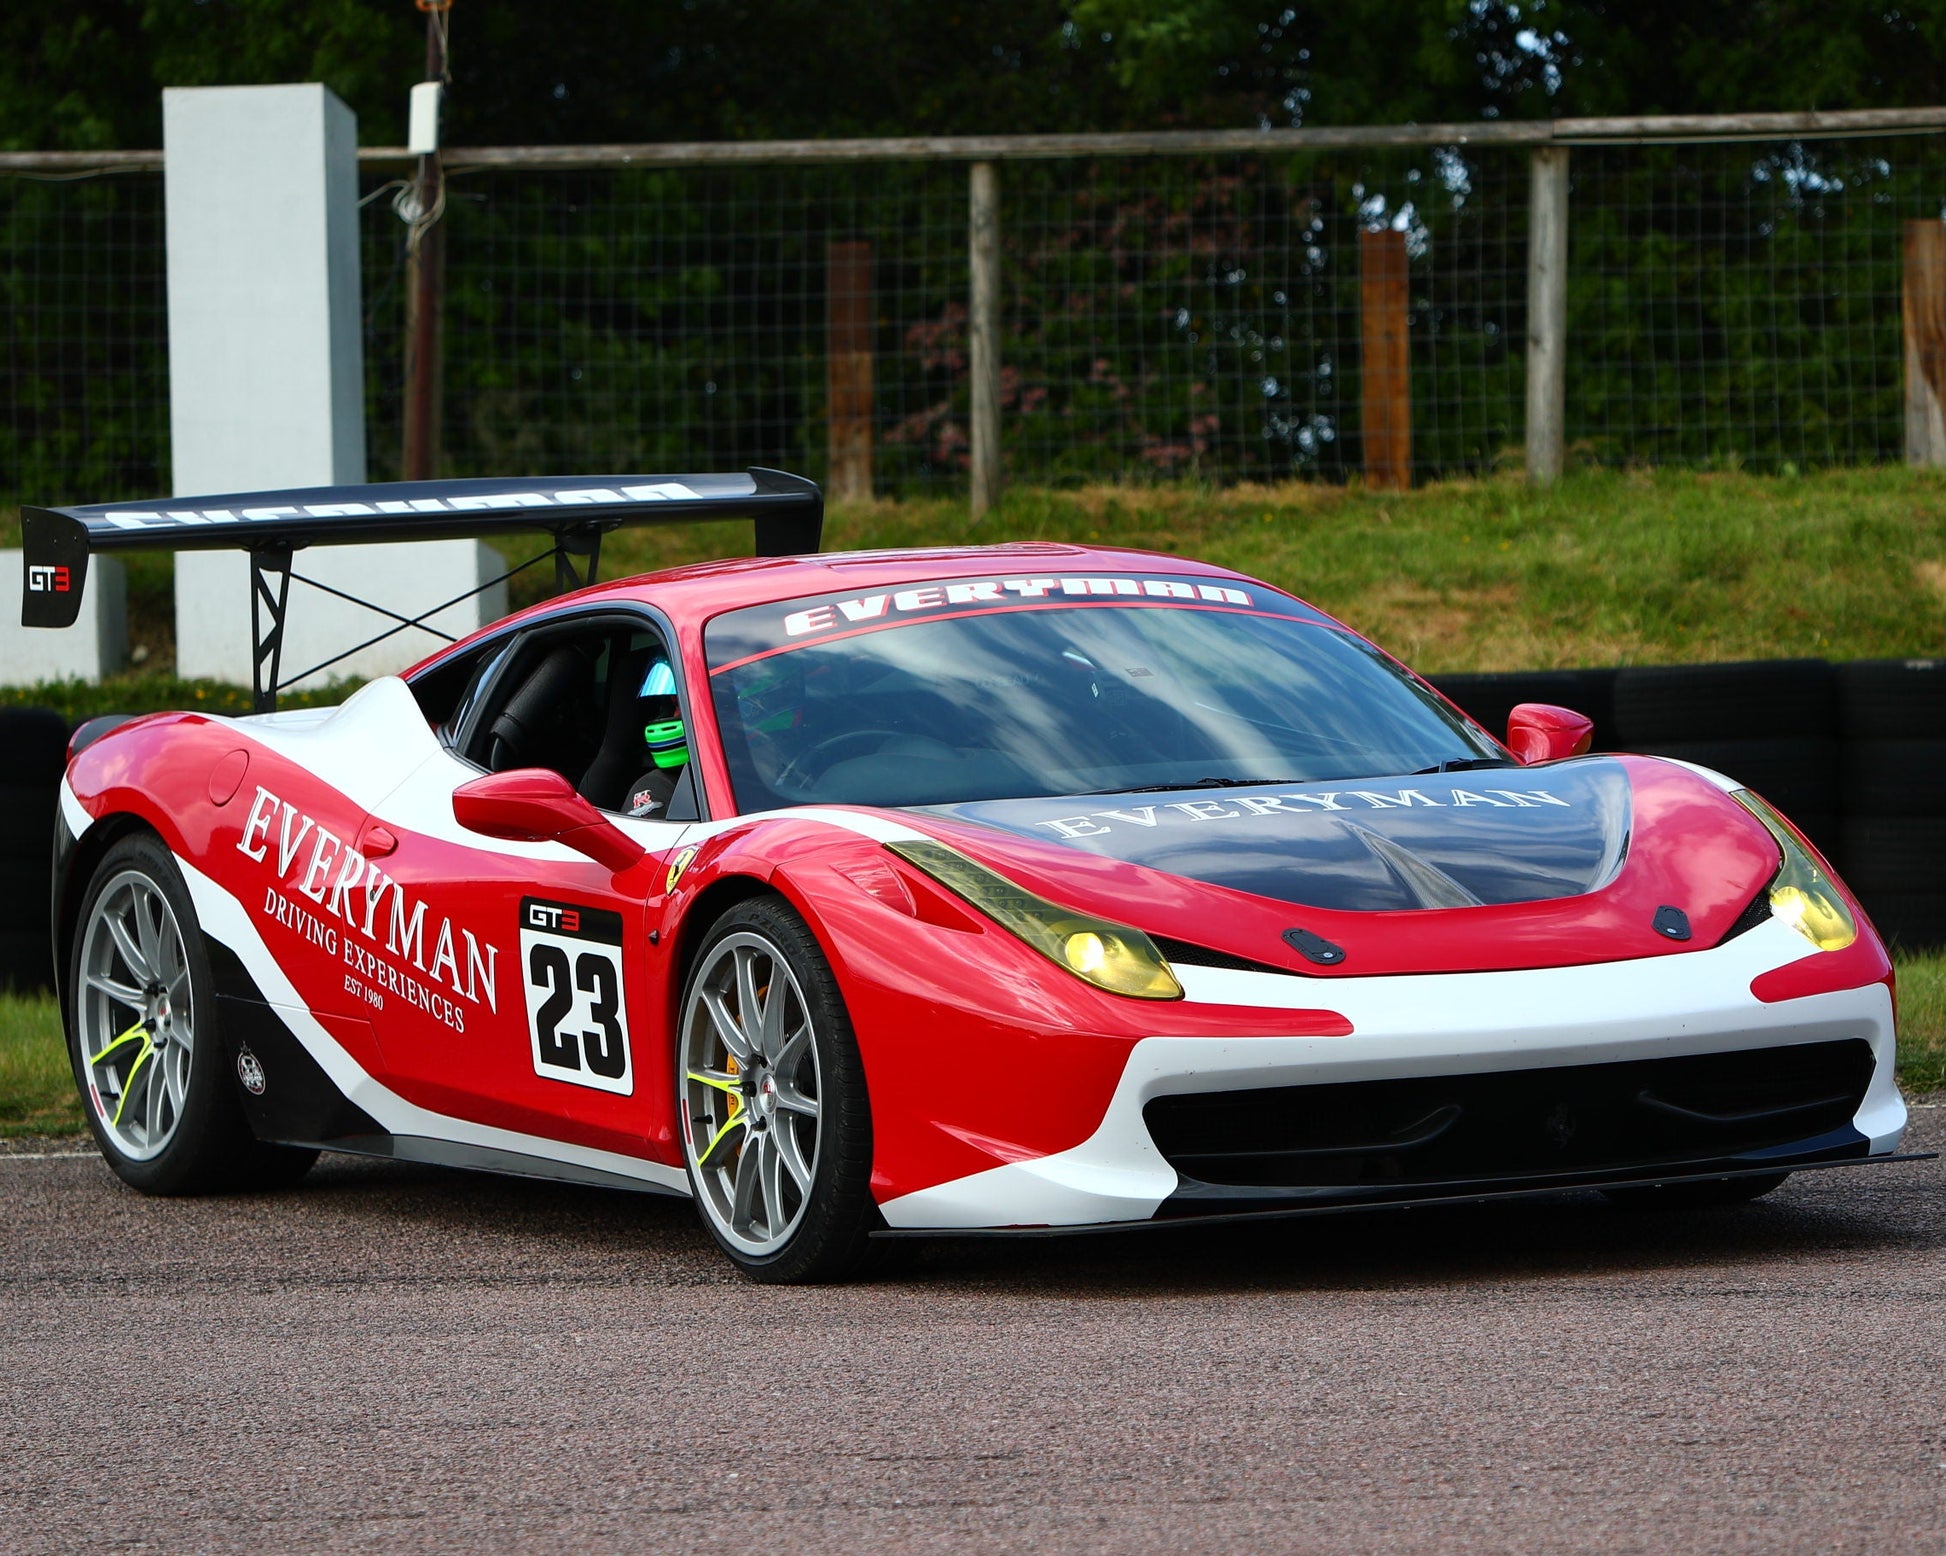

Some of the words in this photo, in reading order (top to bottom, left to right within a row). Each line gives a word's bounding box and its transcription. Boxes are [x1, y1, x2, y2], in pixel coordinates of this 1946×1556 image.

[29, 565, 70, 592] GT3
[1035, 787, 1571, 839] EVERYMAN
[236, 785, 498, 1015] EVERYMAN
[529, 904, 580, 932] GT3
[264, 887, 337, 955] DRIVING
[343, 937, 465, 1033] EXPERIENCES
[344, 974, 363, 997] EST
[364, 986, 383, 1011] 1980
[530, 943, 626, 1079] 23
